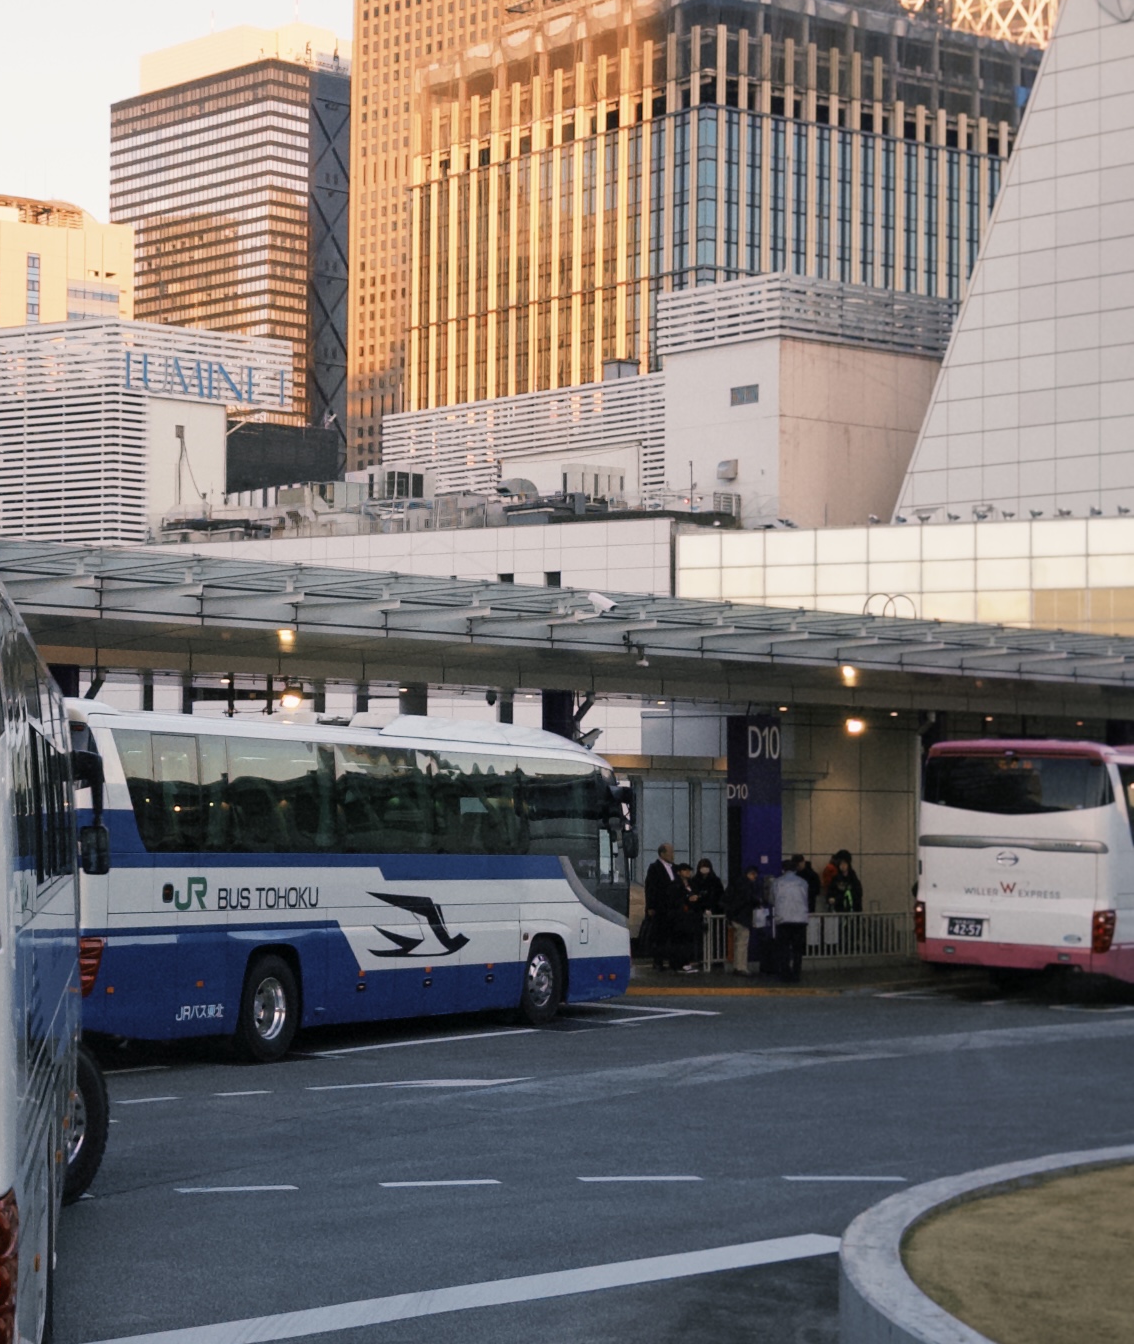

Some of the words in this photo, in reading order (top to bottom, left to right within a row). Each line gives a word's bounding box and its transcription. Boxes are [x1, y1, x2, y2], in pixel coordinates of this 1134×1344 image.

[748, 725, 780, 760] D10
[727, 783, 748, 800] D10
[174, 877, 208, 910] JR
[218, 888, 251, 909] BUS
[255, 887, 319, 909] TOHOKU
[964, 886, 999, 896] WILLER
[1000, 881, 1016, 894] W
[1018, 889, 1061, 899] EXPRESS
[175, 1003, 225, 1022] JRバス東北
